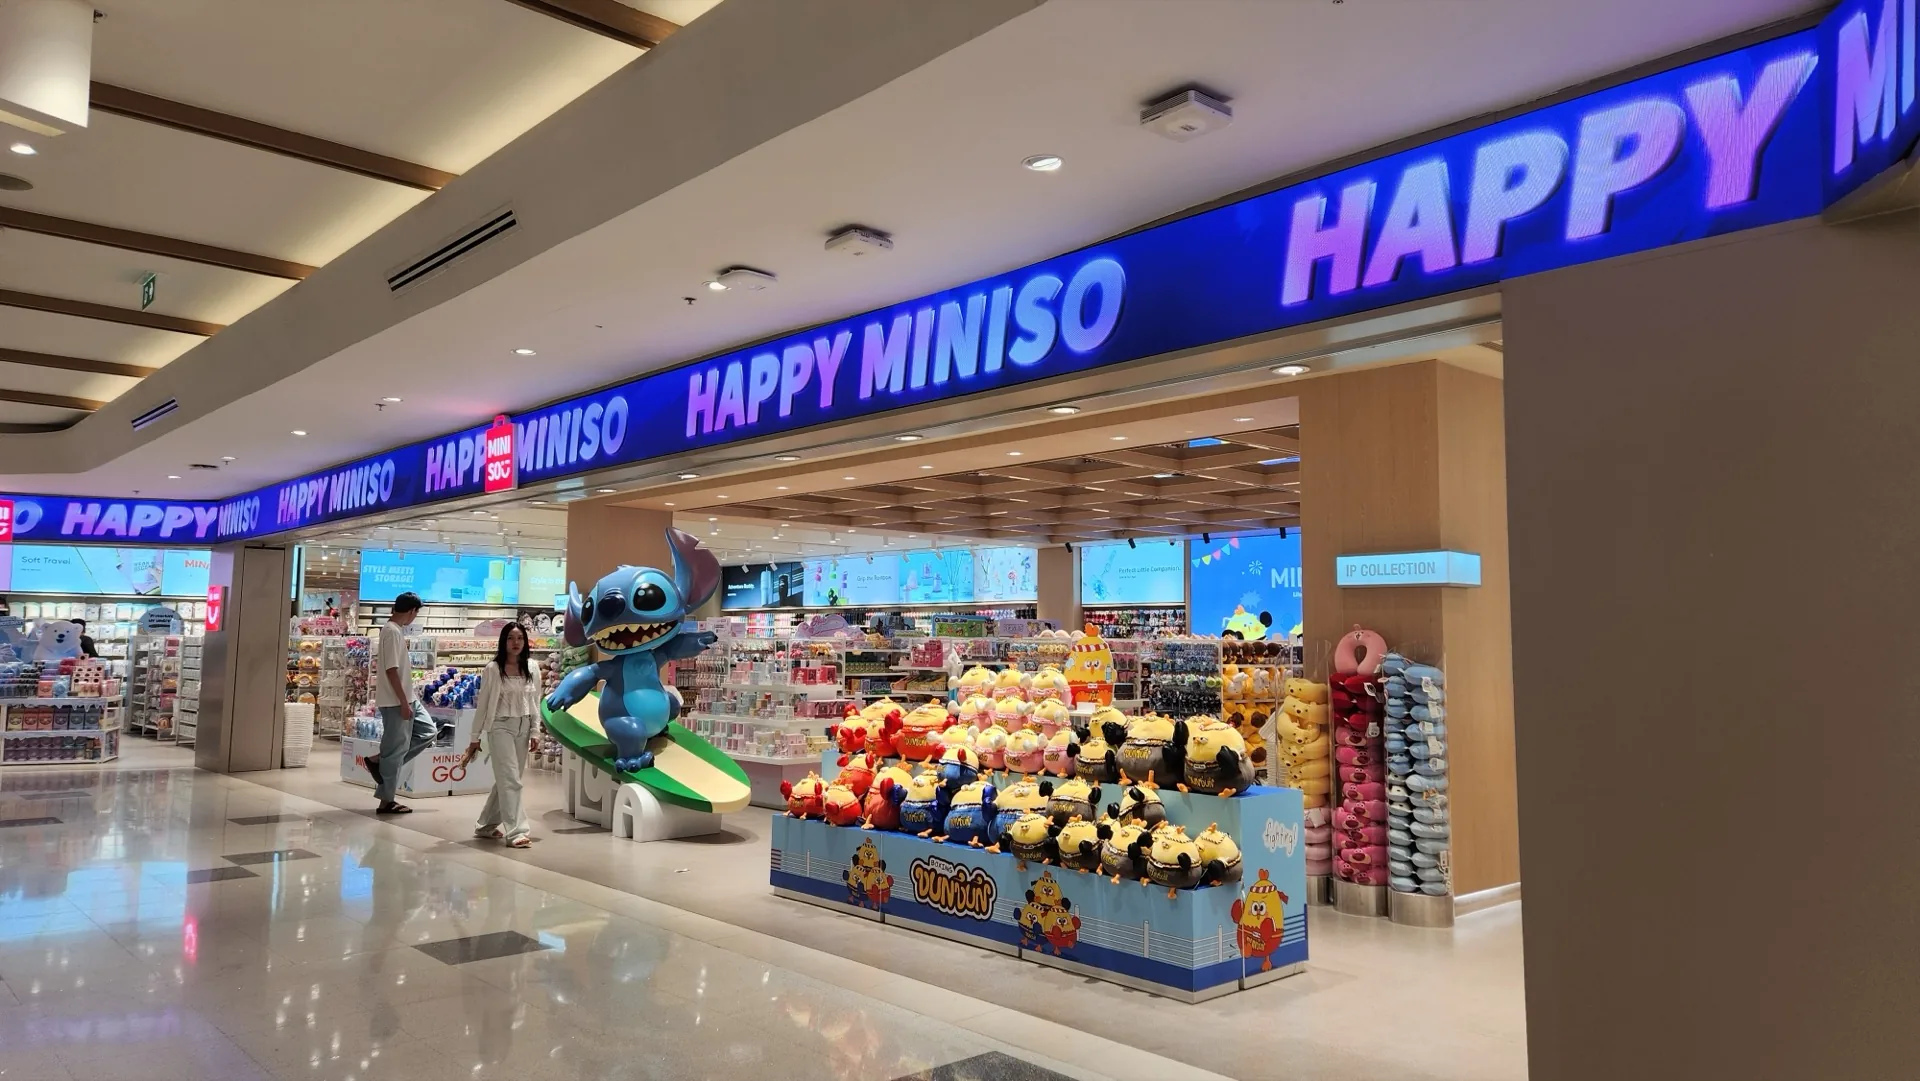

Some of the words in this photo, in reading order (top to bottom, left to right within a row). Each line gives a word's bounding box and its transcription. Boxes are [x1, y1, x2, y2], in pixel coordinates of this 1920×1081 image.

[1281, 50, 1820, 307] HAPPY
[686, 332, 852, 437] HAPPY
[859, 258, 1125, 400] MINISO
[425, 433, 486, 493] HAPP
[518, 395, 629, 470] MINISO
[487, 434, 511, 459] MINI
[278, 476, 328, 523] HAPPY
[329, 459, 396, 511] MINISO
[61, 502, 217, 537] HAPPY
[218, 496, 260, 537] MINISO
[21, 556, 41, 564] Soft
[363, 564, 387, 573] STYLE
[388, 565, 415, 575] MEETS
[1345, 564, 1357, 577] IP
[1360, 561, 1436, 577] COLLECTION
[432, 765, 467, 783] GO
[930, 859, 954, 874] BOXING
